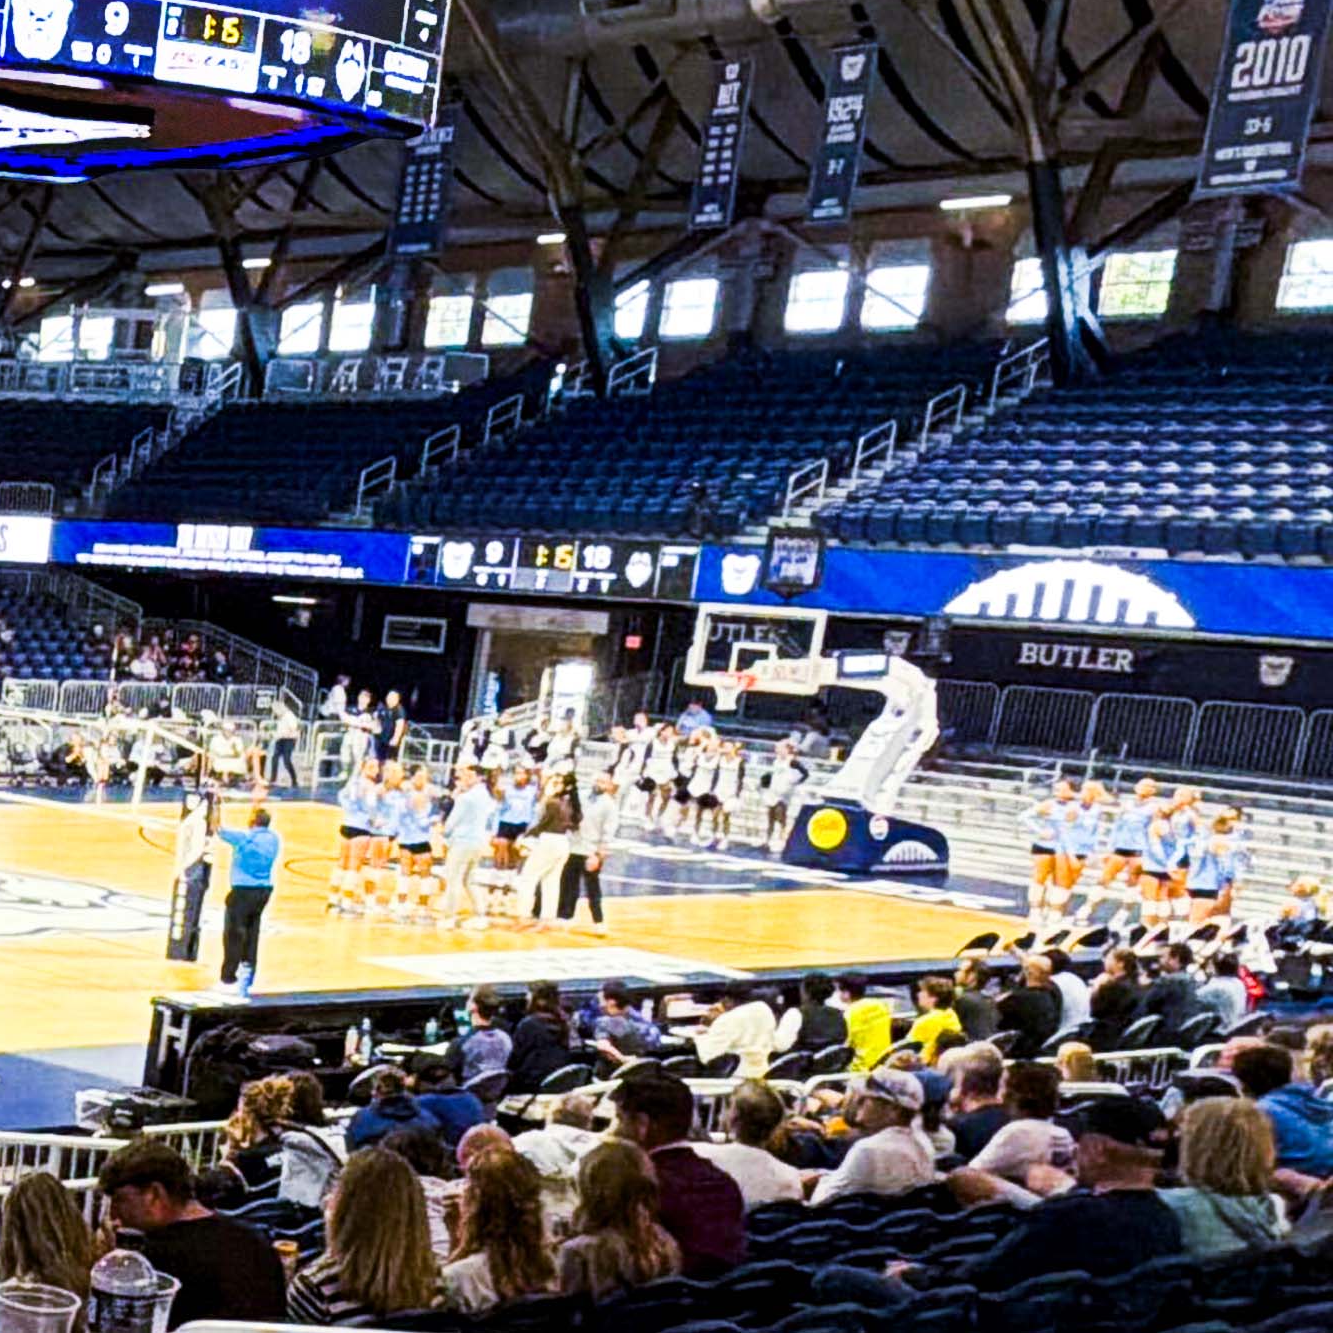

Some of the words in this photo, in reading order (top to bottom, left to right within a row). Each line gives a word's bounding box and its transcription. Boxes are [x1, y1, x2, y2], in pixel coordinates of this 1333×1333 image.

[104, 0, 130, 37] 9
[281, 28, 312, 65] 18
[1231, 33, 1312, 89] 2010
[485, 540, 504, 565] 9
[583, 544, 612, 570] 18
[1019, 641, 1135, 674] BUTLER
